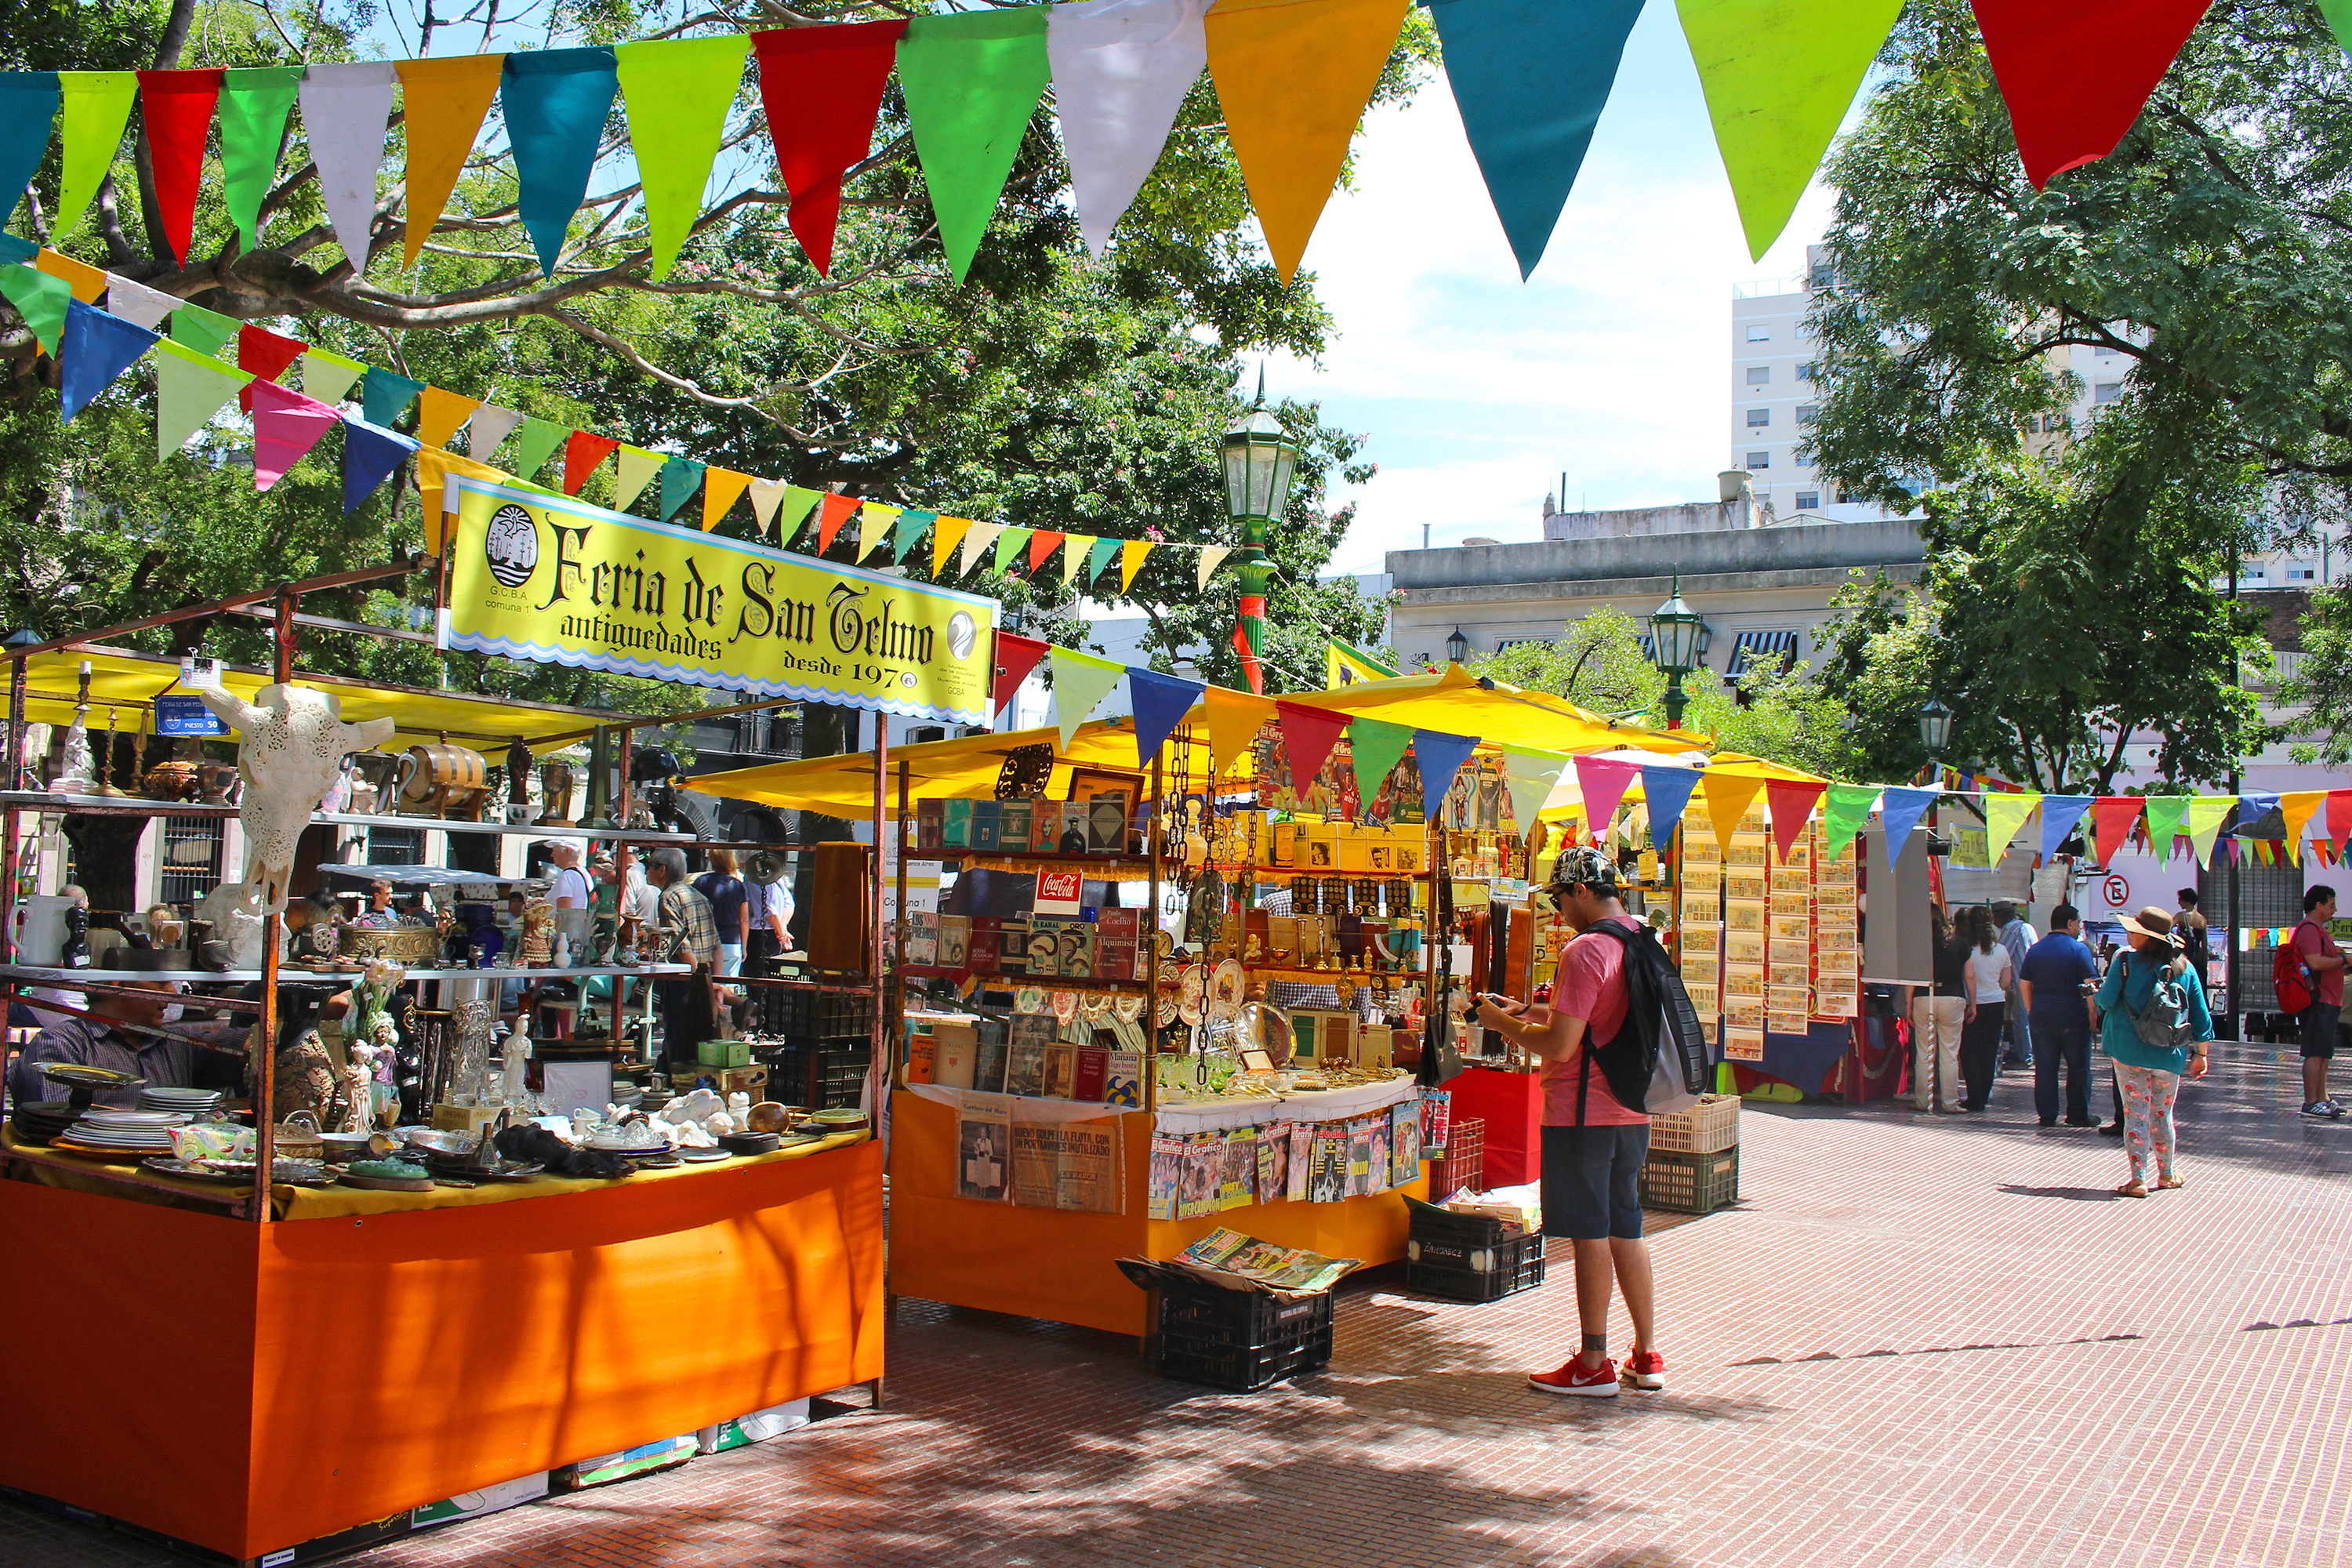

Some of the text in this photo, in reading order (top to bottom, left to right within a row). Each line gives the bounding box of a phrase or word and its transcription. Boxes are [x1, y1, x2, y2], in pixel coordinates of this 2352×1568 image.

[490, 586, 528, 601] G.C.B.A
[535, 512, 935, 666] Feria de San Telmo
[485, 600, 521, 612] comuna
[560, 611, 722, 661] antiguedades
[784, 651, 842, 677] desde
[947, 686, 964, 696] GCBA
[1261, 725, 1269, 736] El
[884, 897, 926, 907] Couna 1
[912, 913, 924, 926] LOS
[1106, 916, 1131, 926] Coelho
[1097, 938, 1137, 948] Alquimista
[1095, 1134, 1109, 1145] CON
[1353, 1133, 1370, 1142] áfico
[1152, 1139, 1182, 1152] El Gráfico
[1184, 1142, 1221, 1156] El Gráfico
